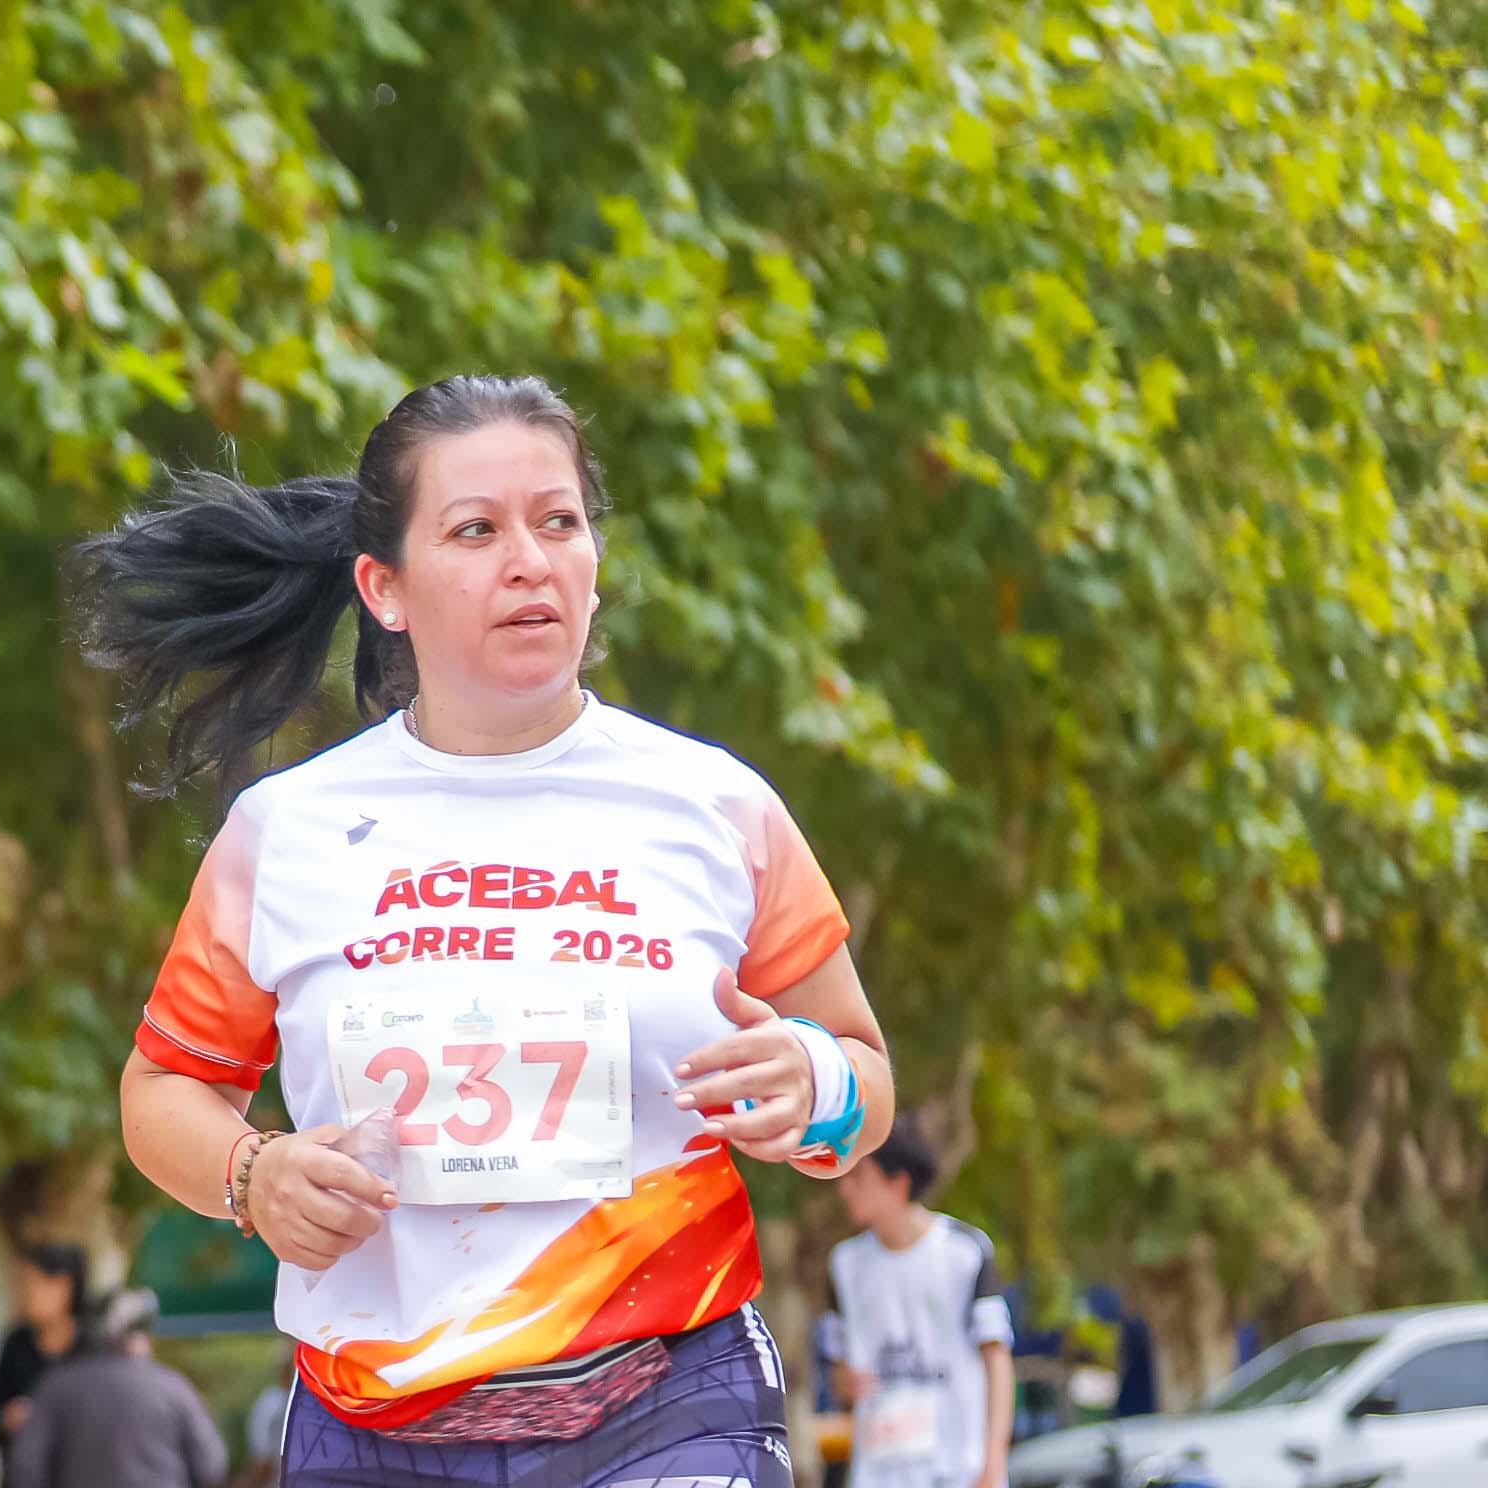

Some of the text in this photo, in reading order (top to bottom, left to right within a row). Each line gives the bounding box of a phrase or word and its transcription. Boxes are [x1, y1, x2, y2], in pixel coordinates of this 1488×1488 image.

[374, 860, 637, 917] ACEBAL
[343, 926, 673, 971] CORRE 2026
[364, 1041, 588, 1146] 237
[442, 1156, 519, 1173] LORENA VERA
